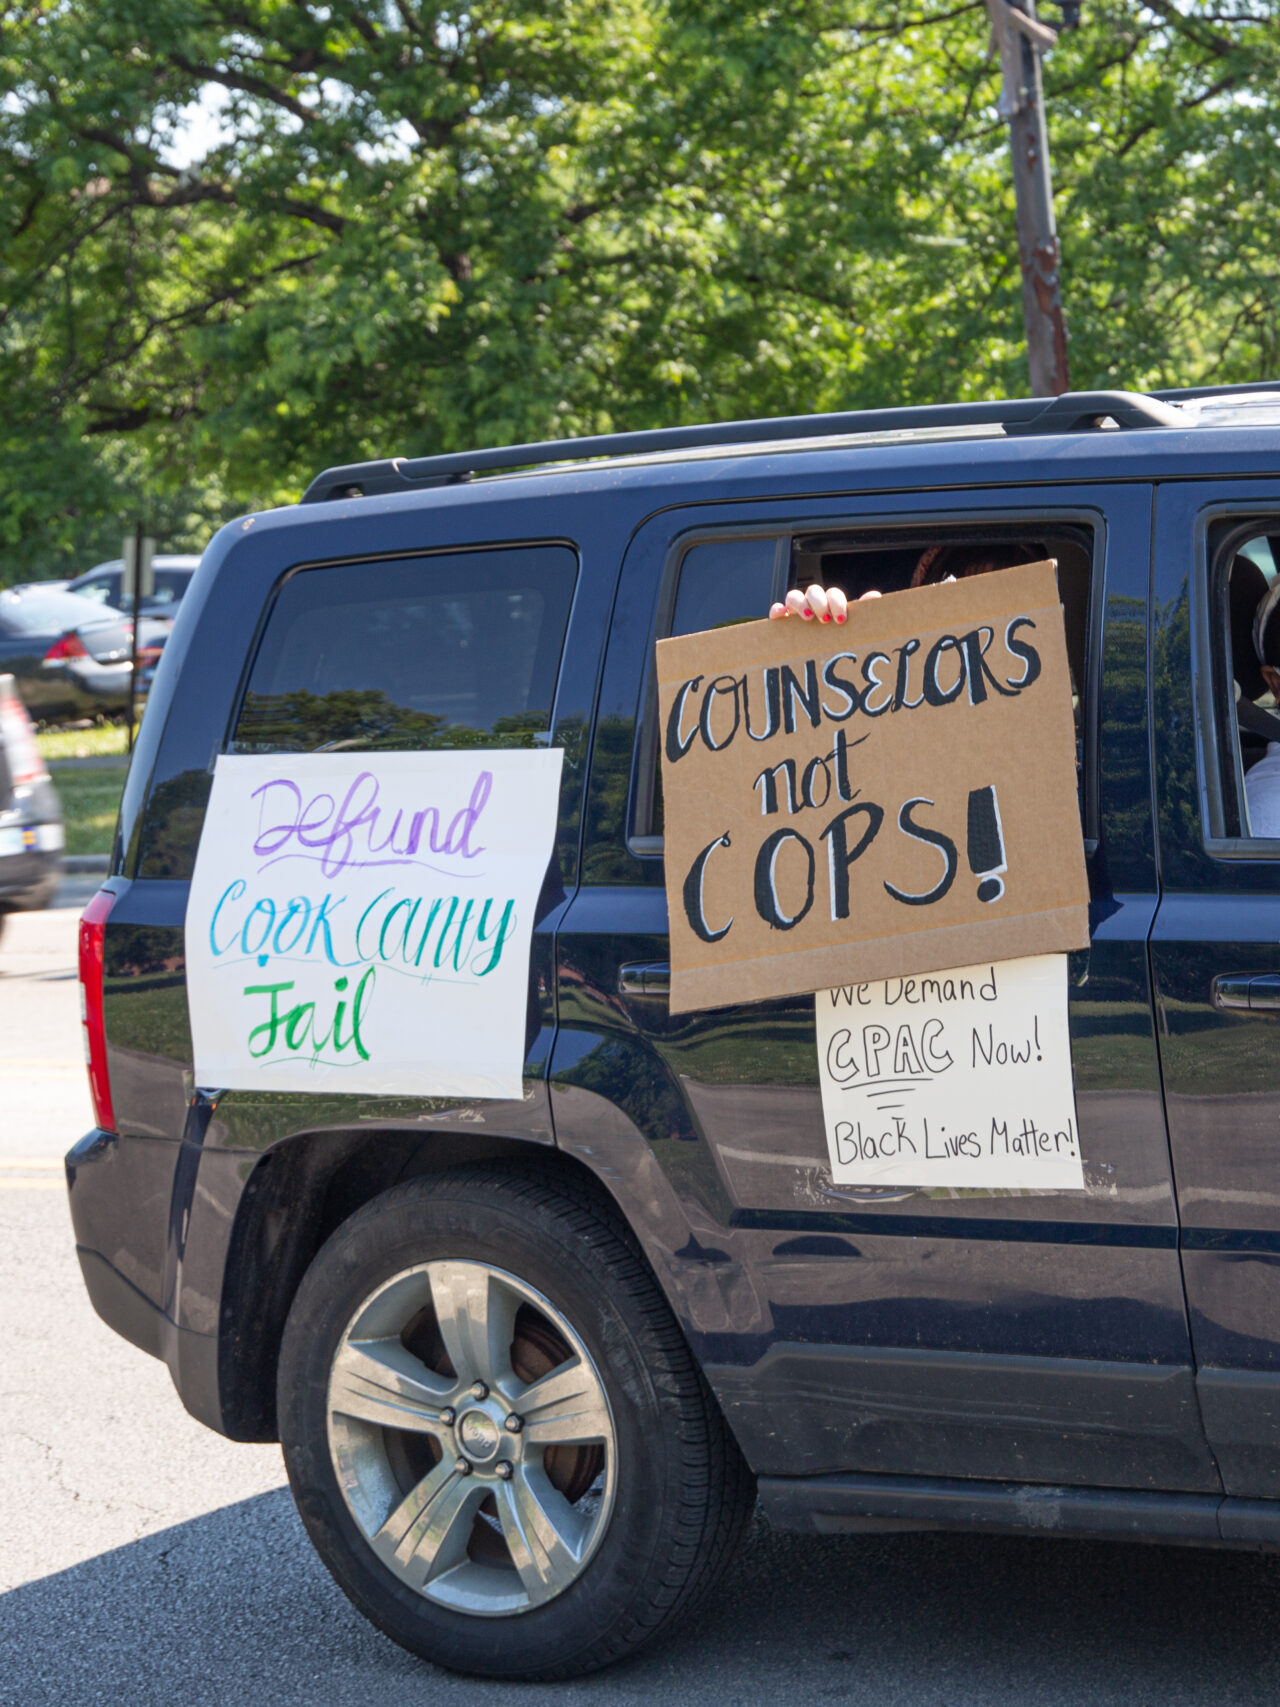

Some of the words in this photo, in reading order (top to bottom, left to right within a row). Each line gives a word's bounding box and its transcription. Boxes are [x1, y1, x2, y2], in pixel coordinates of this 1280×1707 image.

[666, 616, 1041, 763] COUNSELORS
[752, 729, 871, 815] not
[250, 771, 494, 879] Defund
[682, 785, 1008, 943] COPS!
[243, 965, 377, 1061] Jail
[885, 965, 998, 1006] Demand
[827, 1018, 954, 1083] CPAC
[972, 1014, 1043, 1069] Now!
[834, 1118, 918, 1165] Black
[923, 1117, 982, 1160] Lives
[990, 1116, 1077, 1158] Matter!
